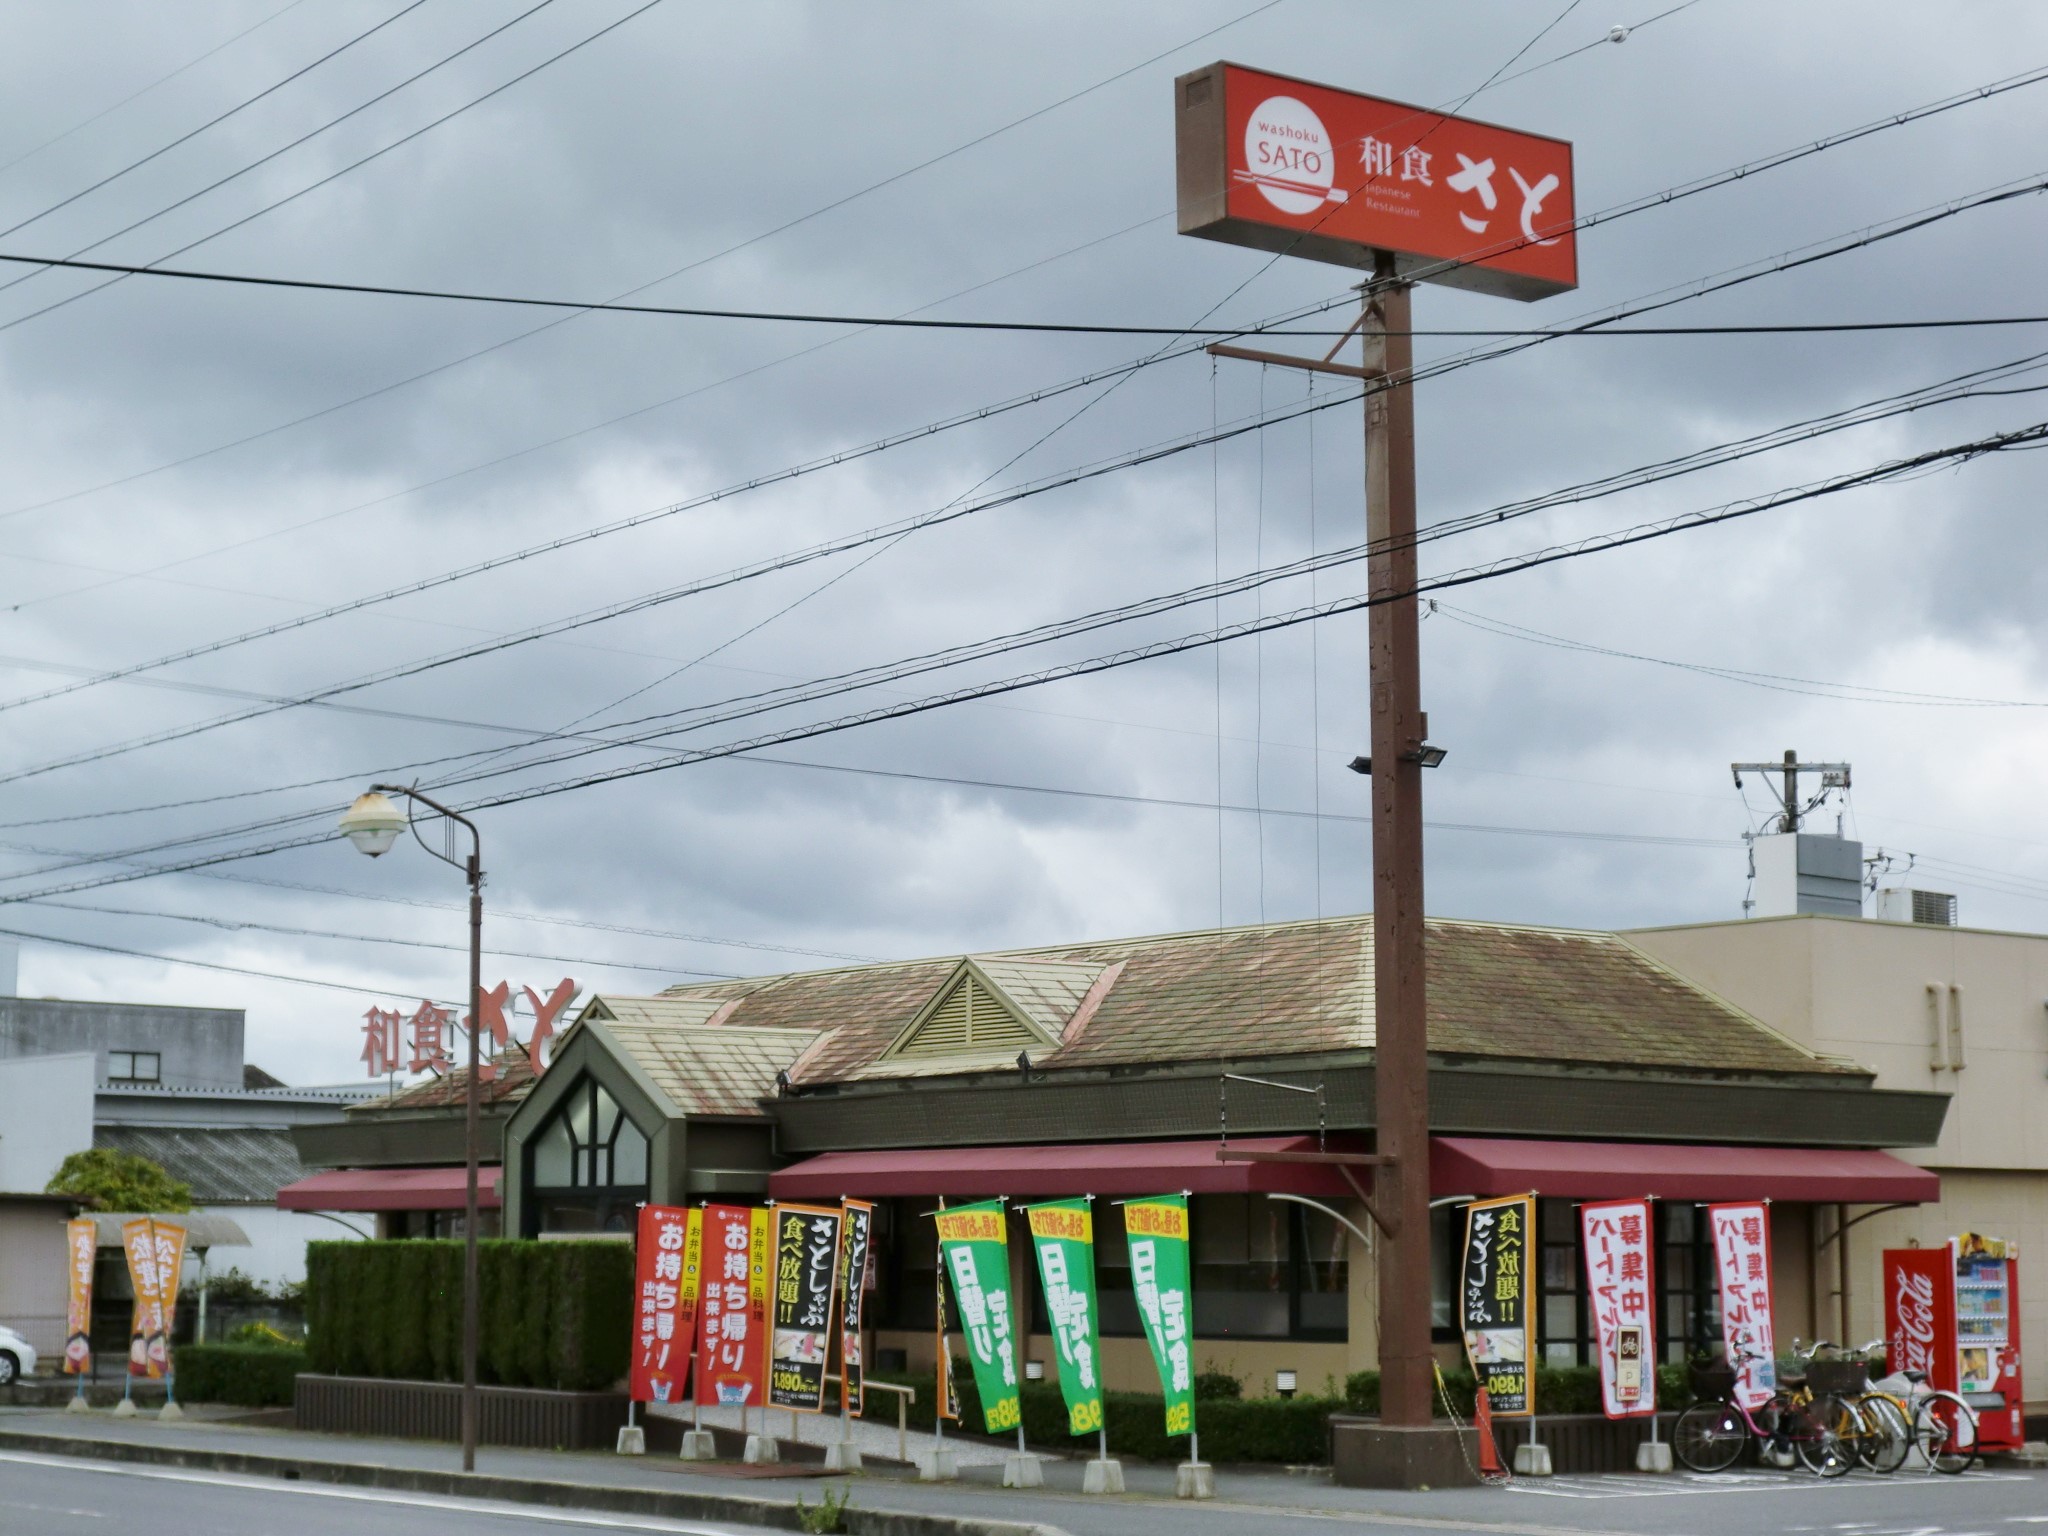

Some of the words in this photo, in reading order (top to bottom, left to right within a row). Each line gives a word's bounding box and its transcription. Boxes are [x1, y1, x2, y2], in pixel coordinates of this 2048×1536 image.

[1258, 120, 1320, 144] washoku
[1258, 140, 1322, 175] SATO
[1359, 135, 1434, 187] 和食
[1446, 152, 1562, 247] さと
[360, 999, 457, 1077] 和食
[655, 1223, 684, 1370] お持ち帰り
[721, 1223, 749, 1372] お持ち帰り
[800, 1217, 834, 1327] さとしゃぶ
[1626, 1372, 1633, 1383] P
